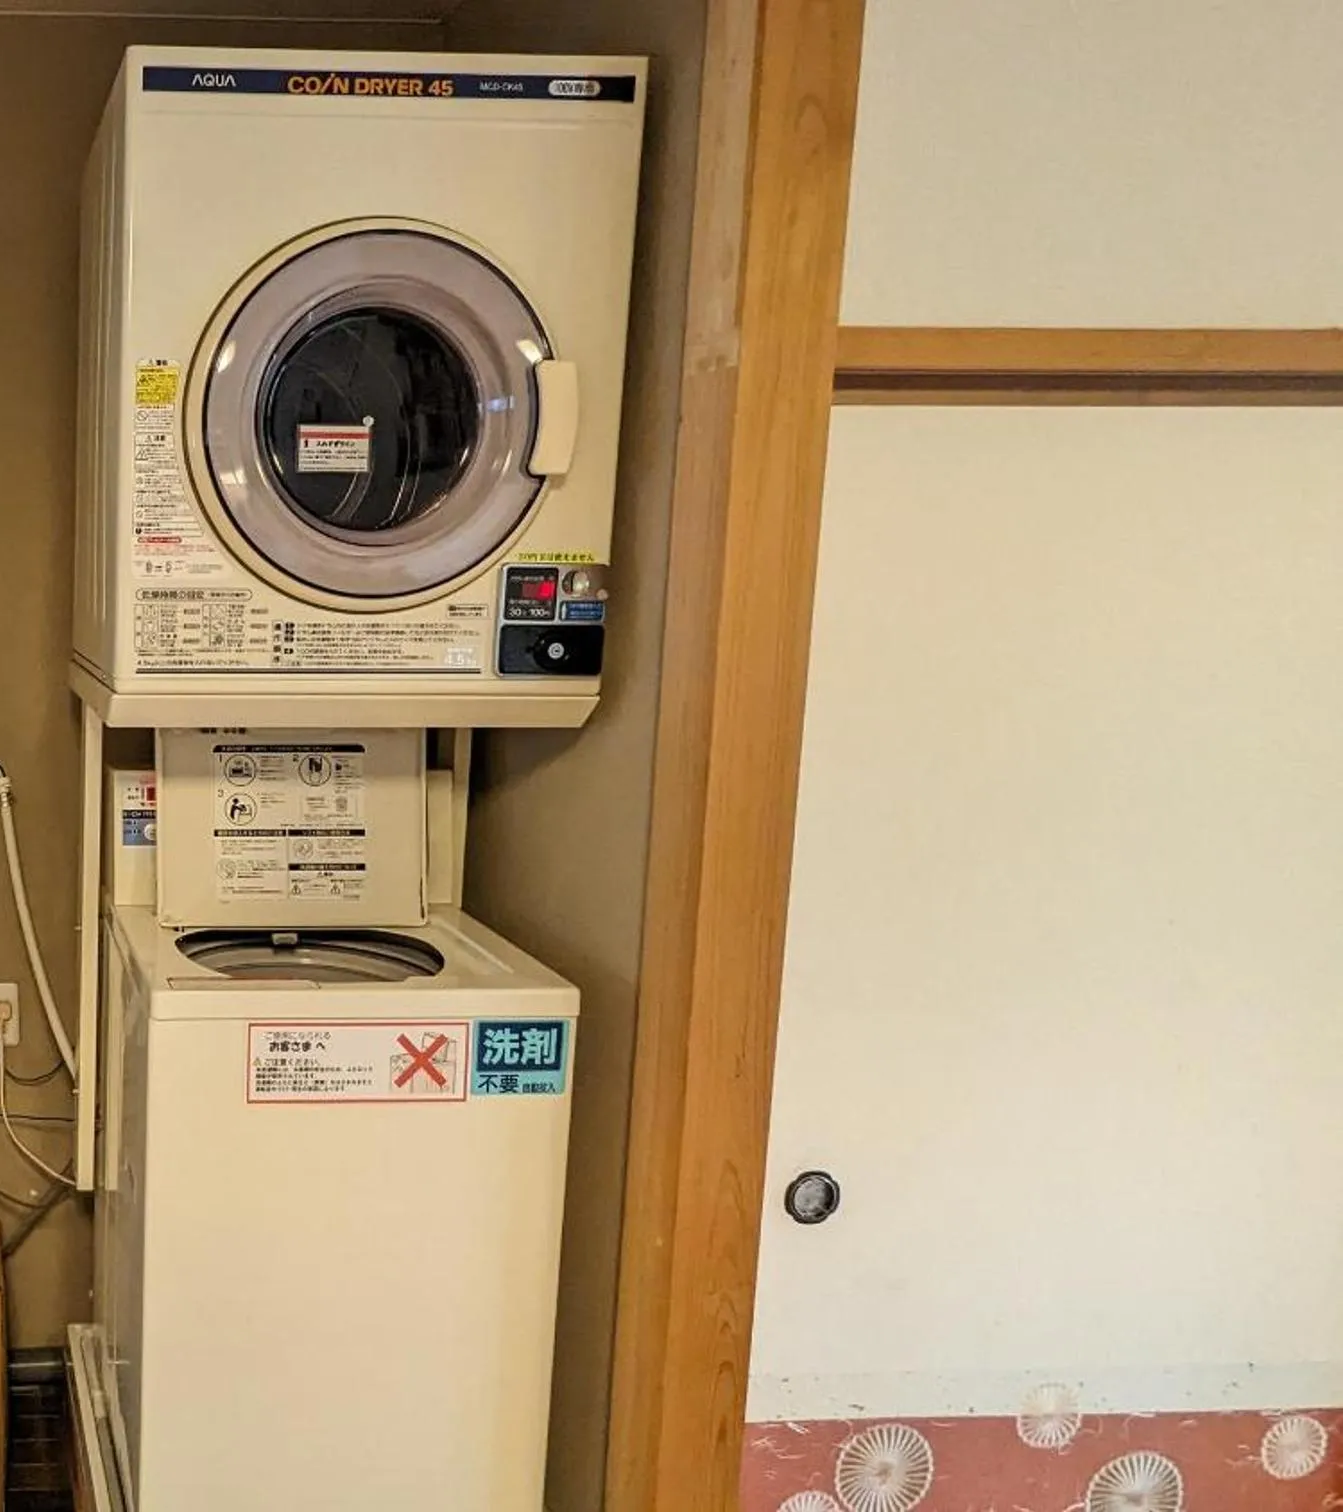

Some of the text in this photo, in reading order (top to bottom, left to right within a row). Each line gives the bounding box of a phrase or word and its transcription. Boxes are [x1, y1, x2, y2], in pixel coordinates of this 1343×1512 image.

[191, 73, 237, 88] AQUA
[287, 73, 454, 97] COIN DRYER 45
[481, 1027, 558, 1066] 洗剤
[478, 1074, 520, 1094] 不要
